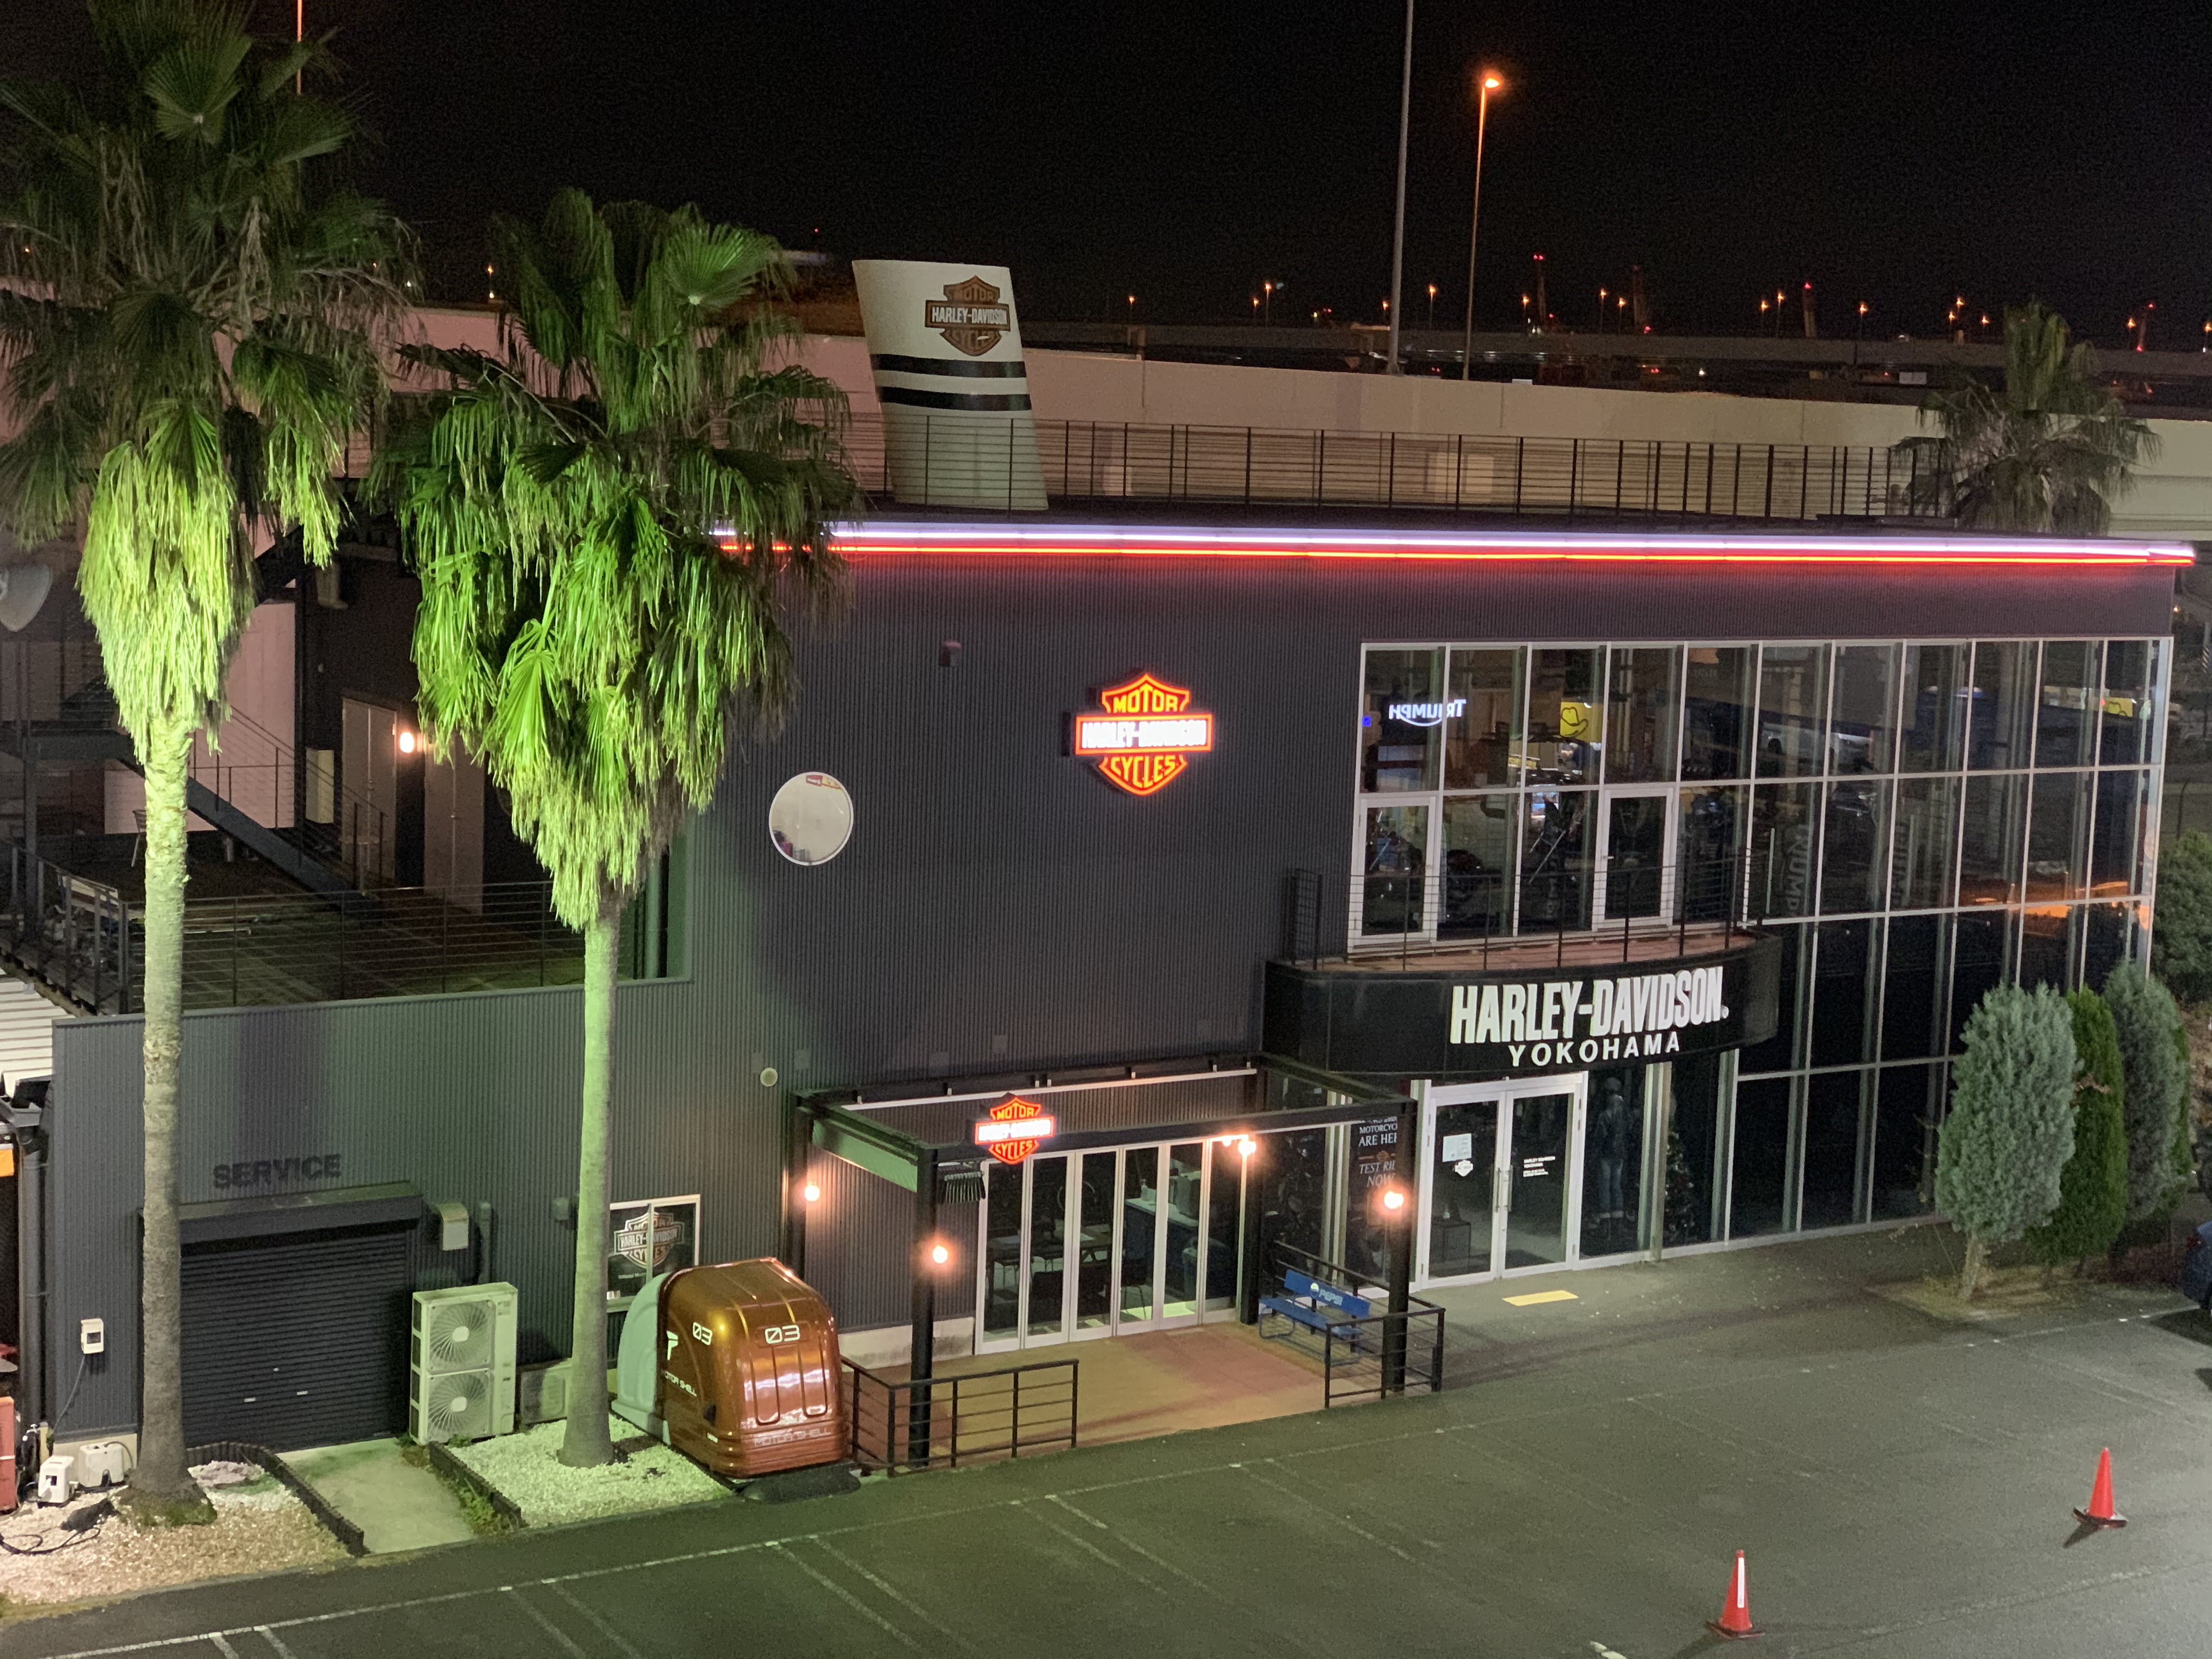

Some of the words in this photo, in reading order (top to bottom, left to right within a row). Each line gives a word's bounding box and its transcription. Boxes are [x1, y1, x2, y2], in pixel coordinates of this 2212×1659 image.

[932, 306, 1007, 325] HARLEY-DAVIDSON
[1113, 683, 1178, 713] MOTOR
[1110, 755, 1176, 788] CYCLES
[1508, 1031, 1680, 1067] YOKOHAMA
[996, 1102, 1035, 1120] MOTOR
[995, 1140, 1033, 1160] CYCLES
[1358, 1135, 1378, 1147] ARE
[213, 1154, 341, 1189] SERVICE
[1359, 1162, 1382, 1174] TEST
[634, 1218, 667, 1231] MOOR
[634, 1245, 666, 1262] CYES
[692, 1322, 713, 1345] 03
[765, 1324, 800, 1344] 03
